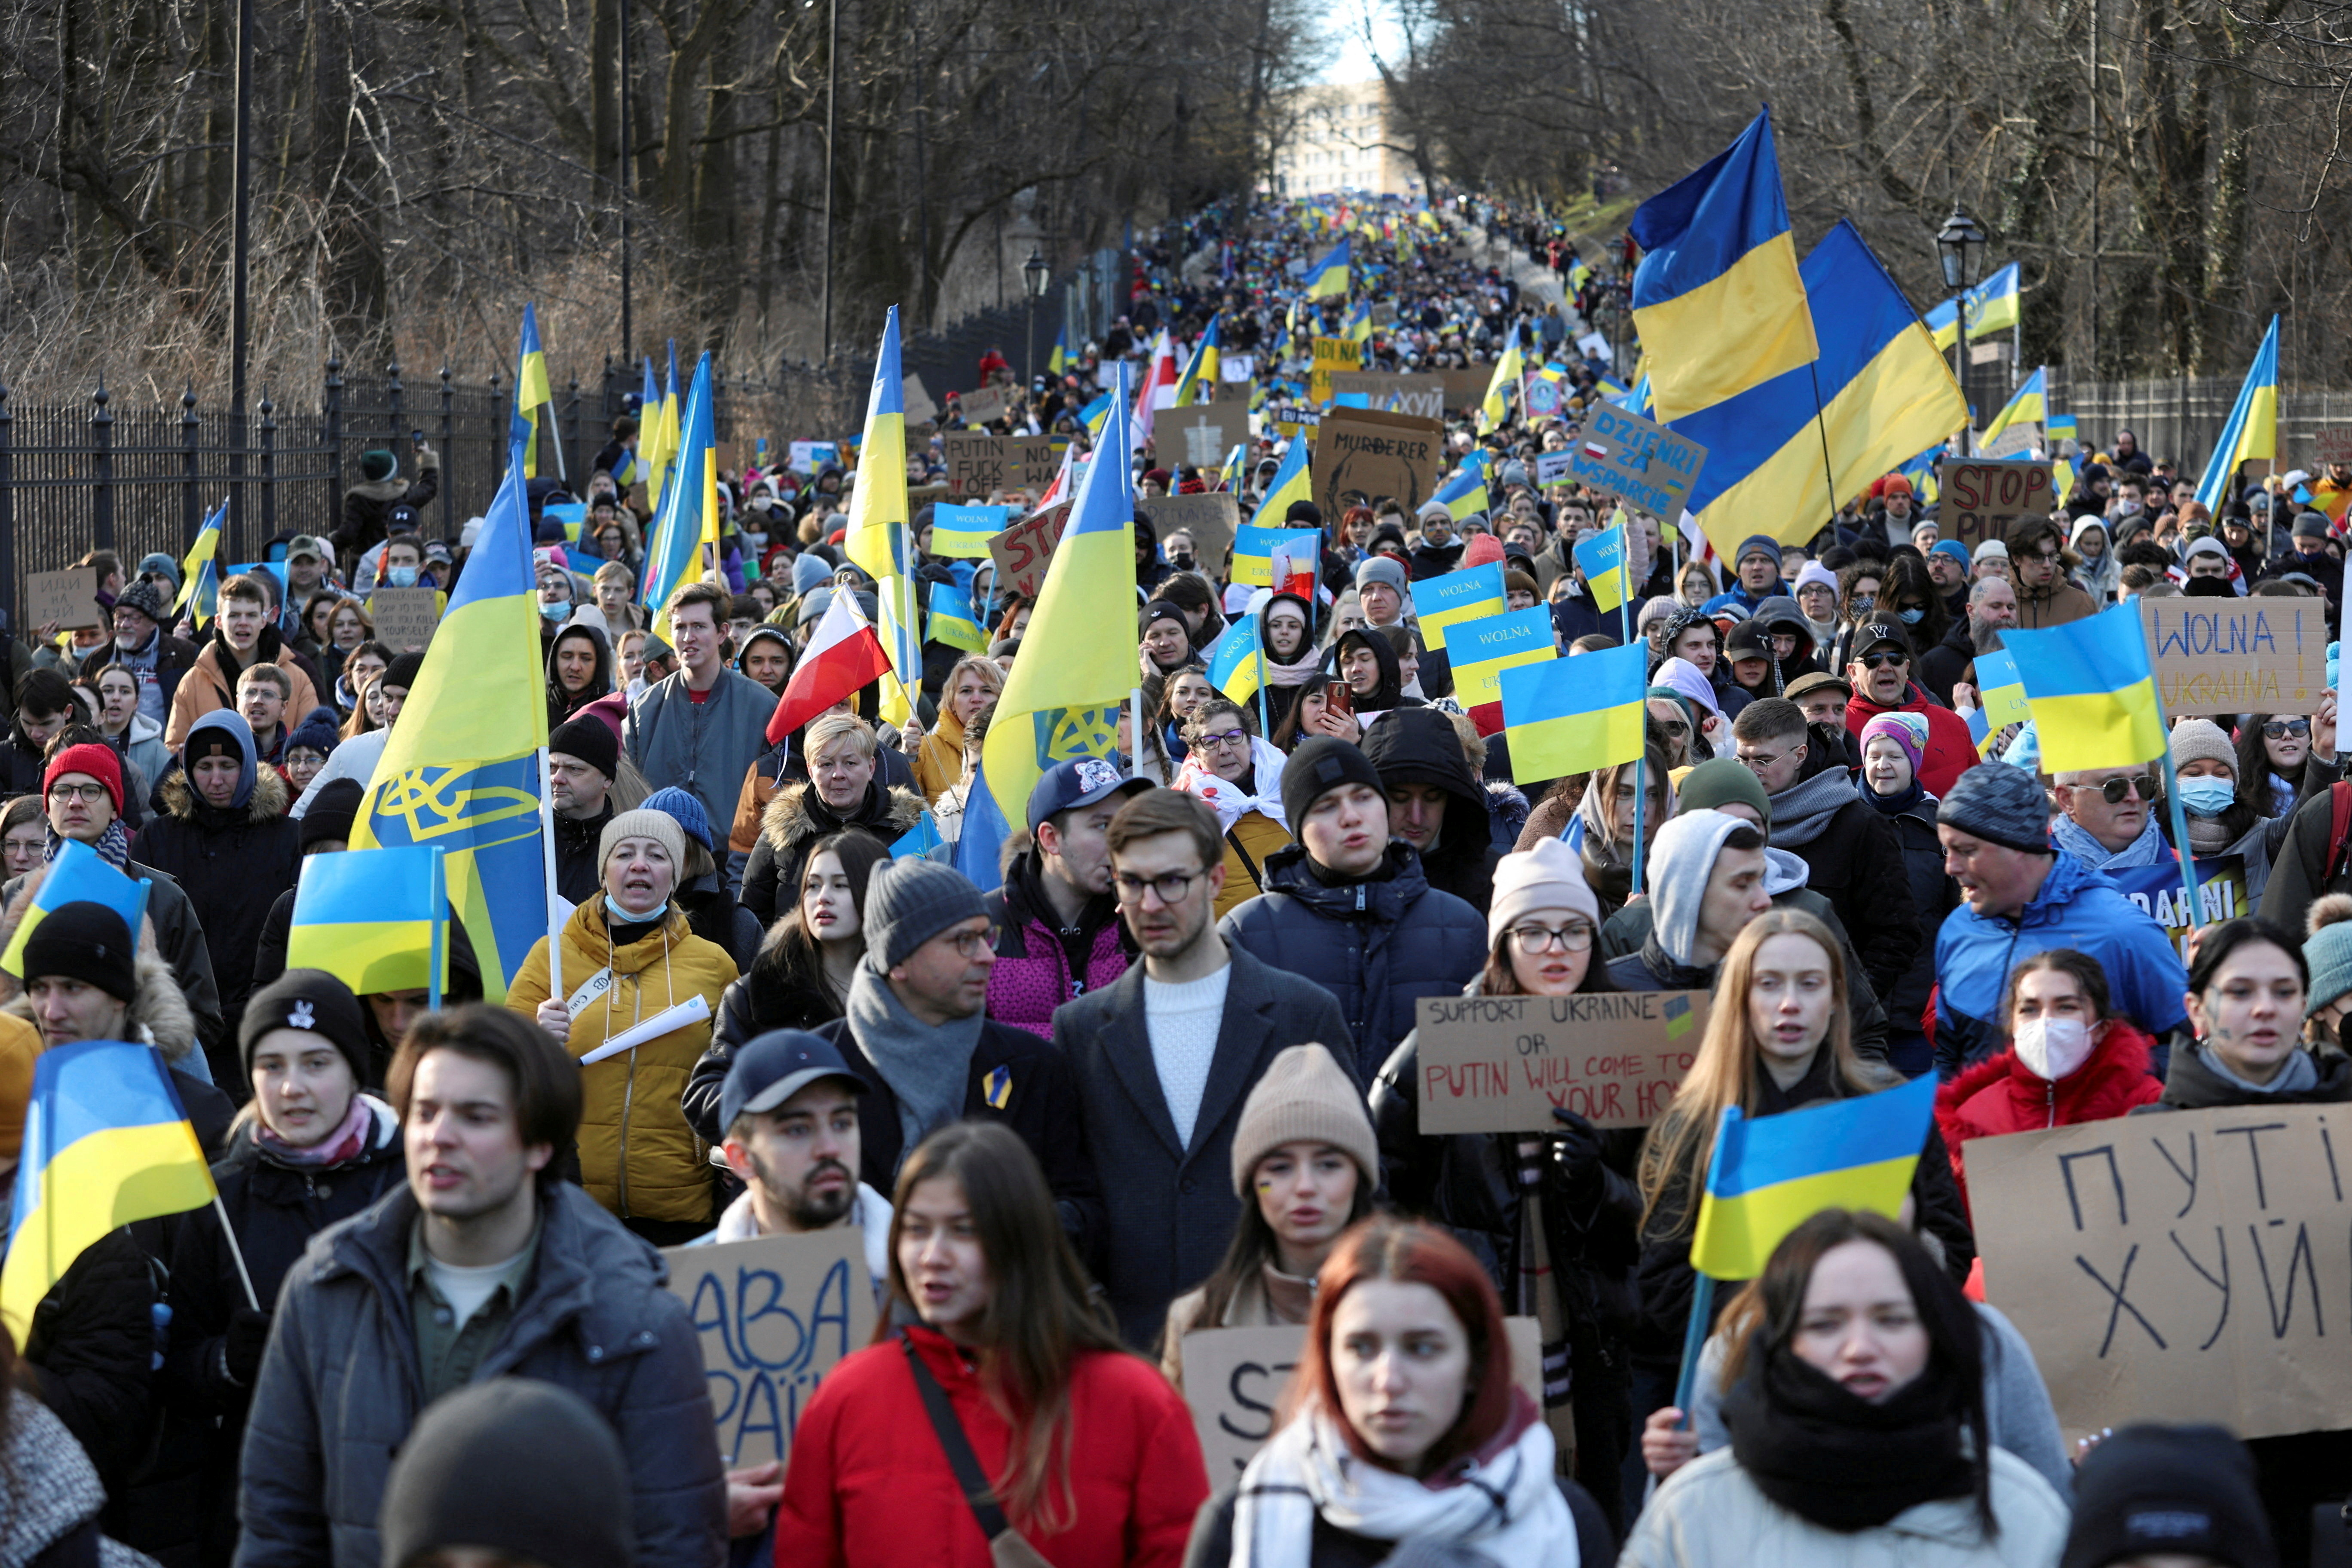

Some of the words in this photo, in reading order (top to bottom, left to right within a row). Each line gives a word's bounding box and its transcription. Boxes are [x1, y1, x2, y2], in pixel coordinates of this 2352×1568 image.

[2316, 429, 2352, 442] PUTI
[951, 439, 1004, 457] PUTIN
[1026, 447, 1051, 463] NO
[1334, 432, 1428, 461] MURDERER
[958, 459, 1003, 478] FUCK
[1616, 447, 1649, 473] ZA
[1026, 468, 1060, 483] WA
[967, 478, 1002, 494] OFF
[1954, 465, 2047, 510] STOP
[1957, 512, 2019, 543] PUT
[41, 577, 80, 593] ИДИ
[1439, 579, 1482, 598] WOLNA
[52, 593, 68, 604] НА
[43, 604, 74, 618] ХУЙ
[416, 615, 435, 625] KILL
[384, 625, 429, 636] YOURSELF
[1478, 625, 1532, 645] WOLNA
[1870, 625, 1888, 638] V
[2153, 607, 2276, 658] WOLNA
[2160, 668, 2280, 707] UKRAINA
[1428, 998, 1531, 1024] SUPPORT
[1550, 995, 1659, 1023] UKRAINE
[1516, 1033, 1549, 1055] OR
[1426, 1060, 1508, 1102] PUTIN
[1523, 1056, 1581, 1090] WILL
[1586, 1055, 1645, 1078] COME
[1656, 1052, 1696, 1073] TO
[1547, 1081, 1625, 1124] YOUR
[2075, 1218, 2352, 1359] ХУЙ
